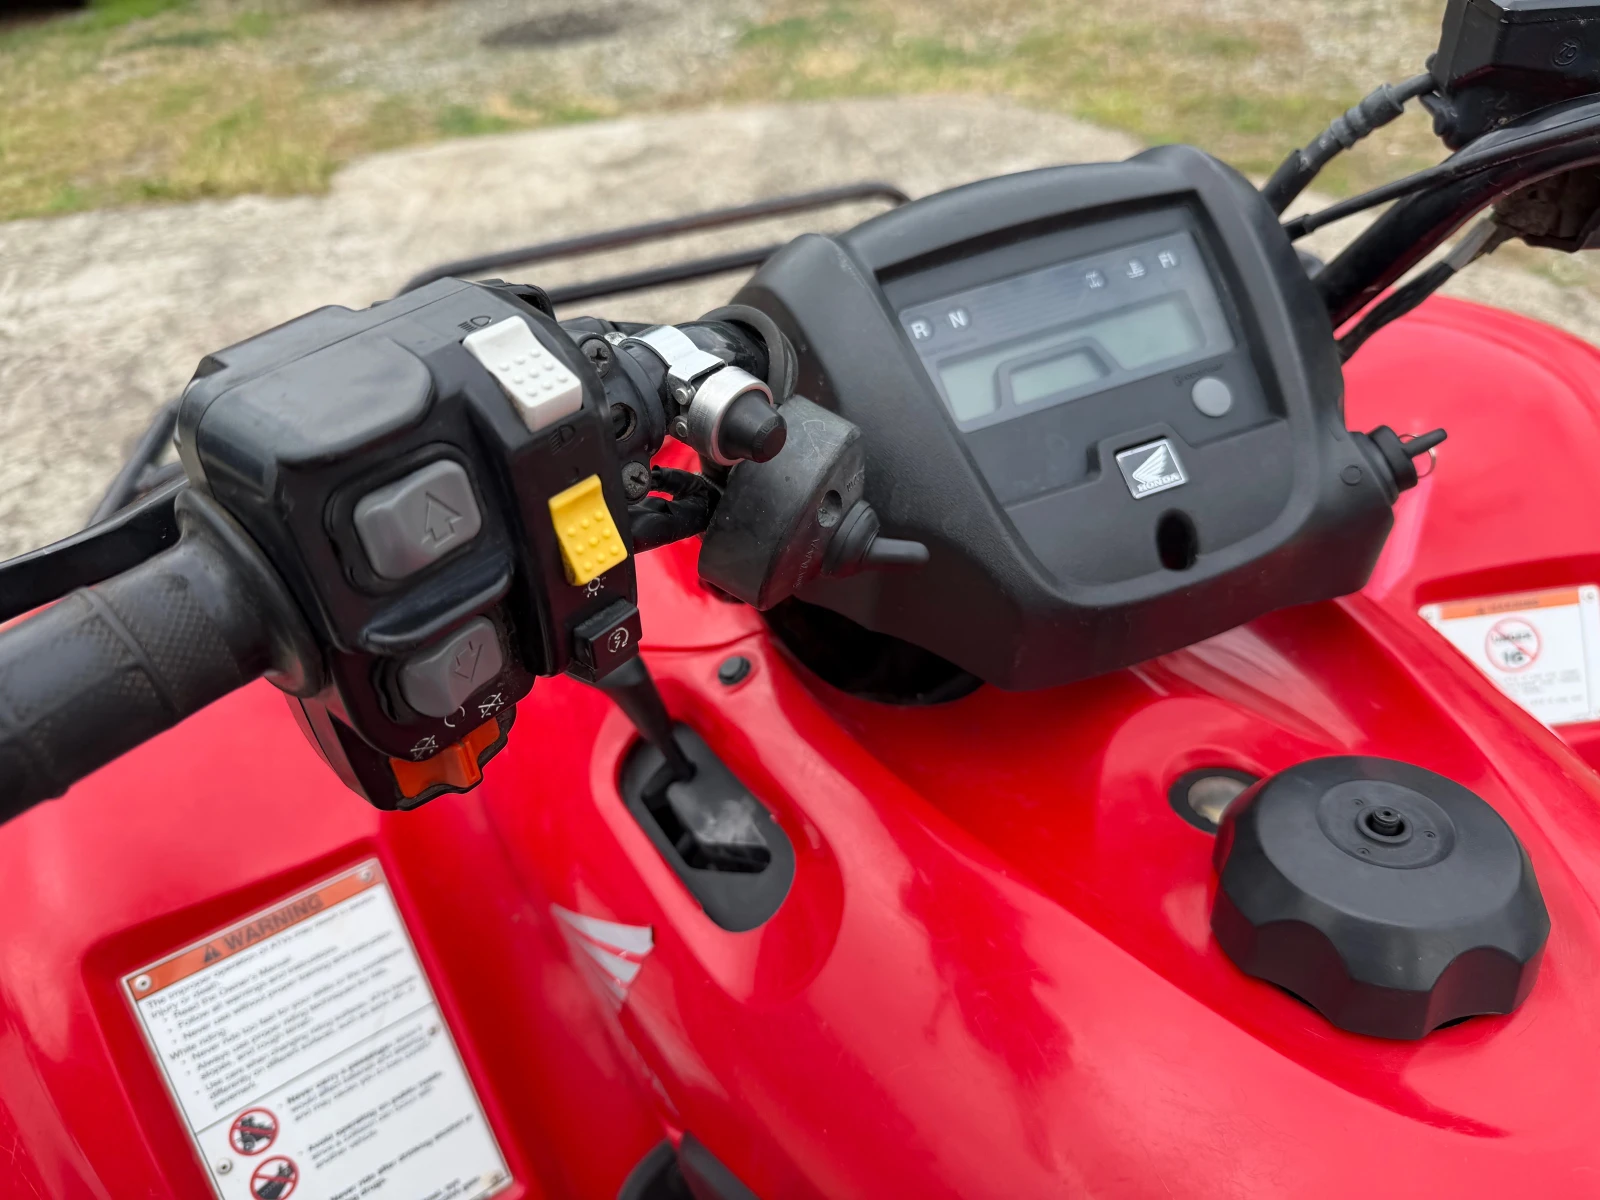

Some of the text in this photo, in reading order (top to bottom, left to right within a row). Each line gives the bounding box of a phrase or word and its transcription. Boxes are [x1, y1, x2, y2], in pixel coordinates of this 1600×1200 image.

[910, 311, 967, 340] R N
[1137, 473, 1180, 492] HONDA
[223, 890, 324, 951] WARNING
